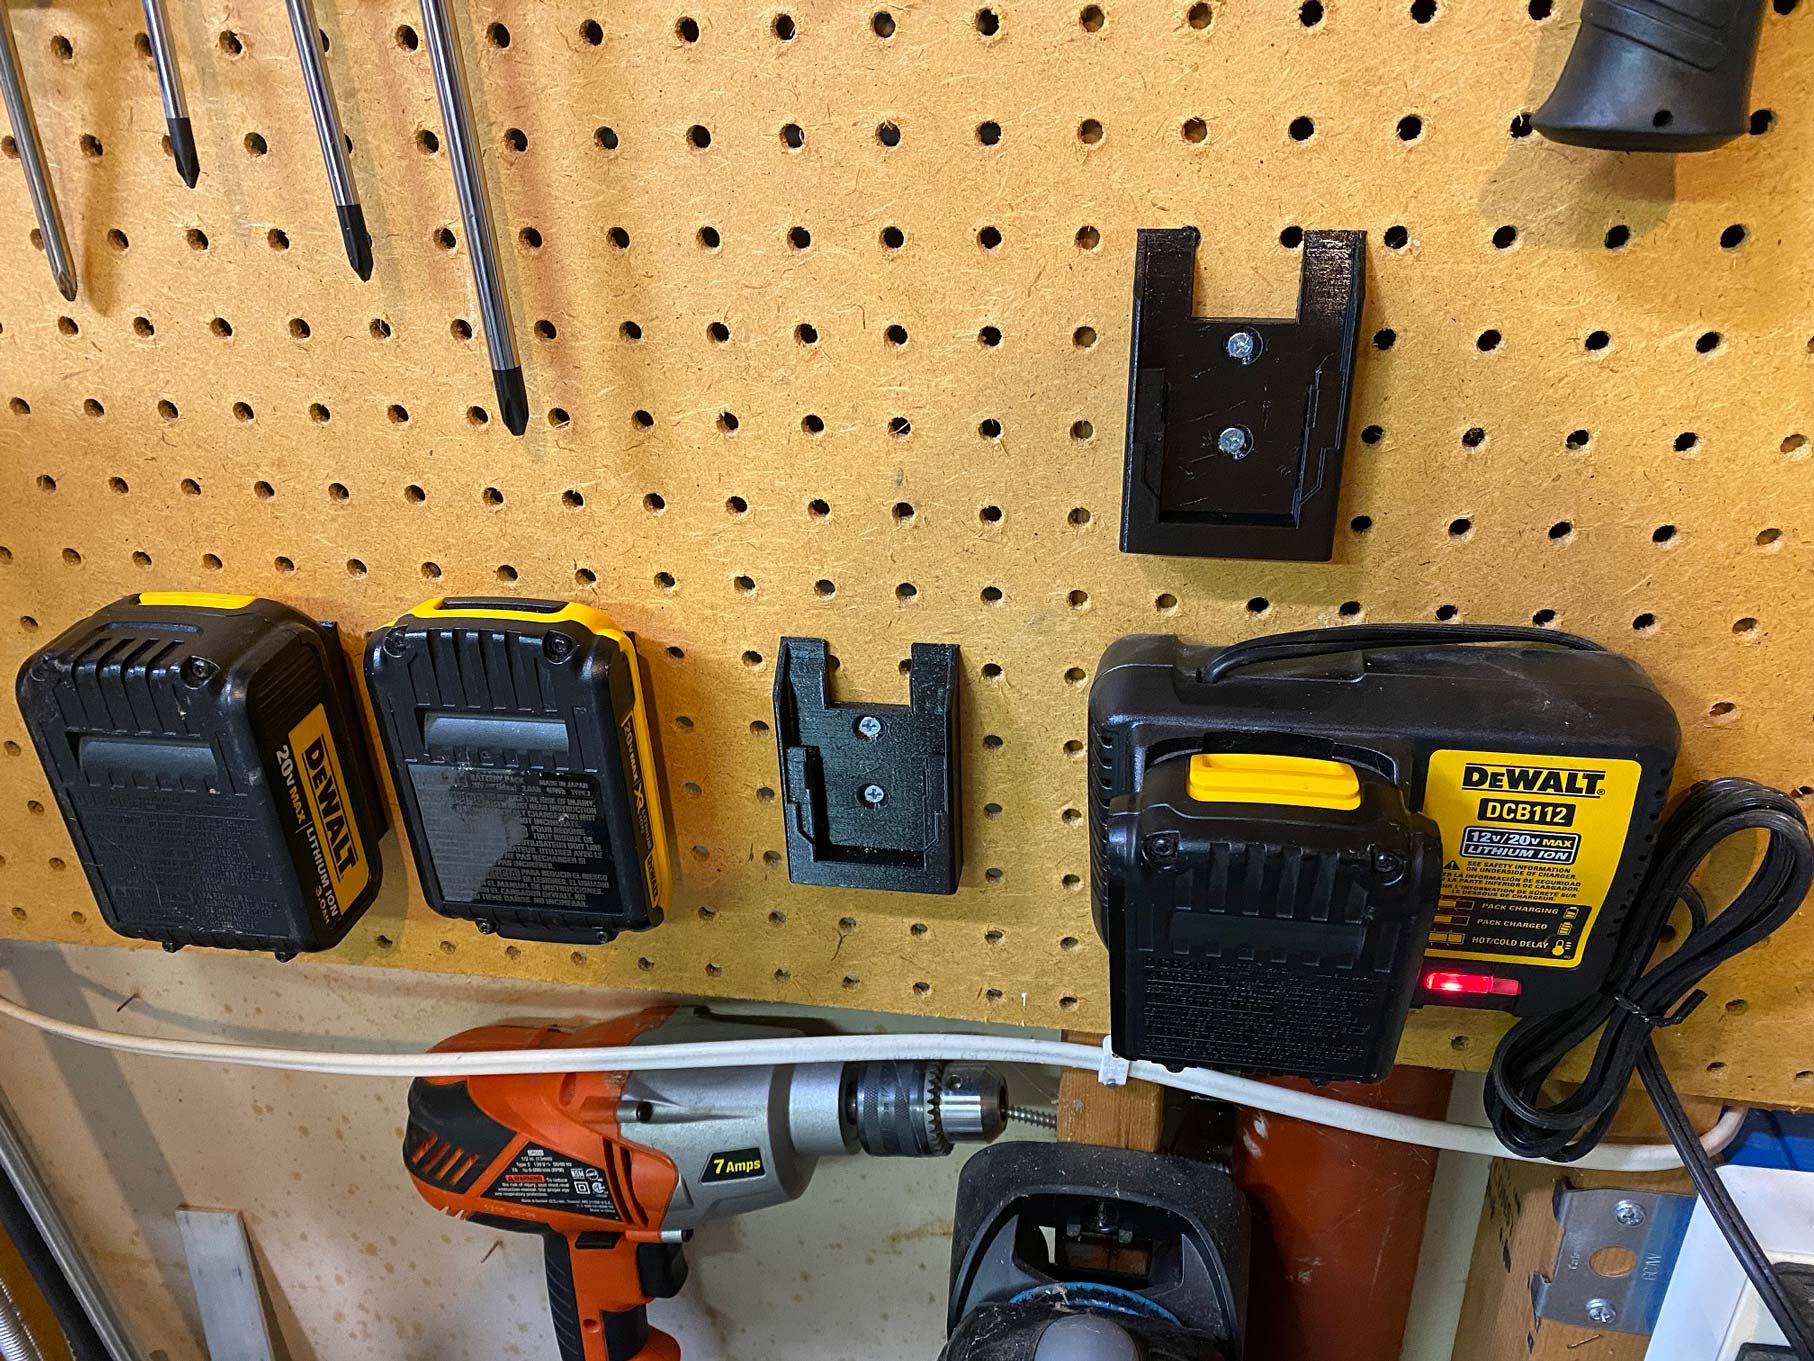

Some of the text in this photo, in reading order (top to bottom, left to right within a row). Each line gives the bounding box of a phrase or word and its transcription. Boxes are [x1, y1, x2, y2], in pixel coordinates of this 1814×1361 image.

[1486, 801, 1567, 823] DCB112
[1542, 838, 1574, 848] MAX
[289, 786, 306, 824] MAX
[306, 827, 330, 888] LITHIUM
[325, 889, 339, 917] ION
[1467, 845, 1569, 860] LITHIUM ION
[1479, 867, 1525, 875] UNDERSIDE
[1484, 861, 1514, 869] SAFETY
[1514, 864, 1571, 874] INFORMATION
[1485, 880, 1521, 888] INFERIOR
[1535, 879, 1582, 887] SEGURIDAD
[1481, 902, 1559, 915] PACK CHARGING
[1476, 918, 1548, 930] PACK CHARGED
[1471, 936, 1550, 949] HOT/COLD DELAY
[713, 1158, 761, 1174] 7 Amps
